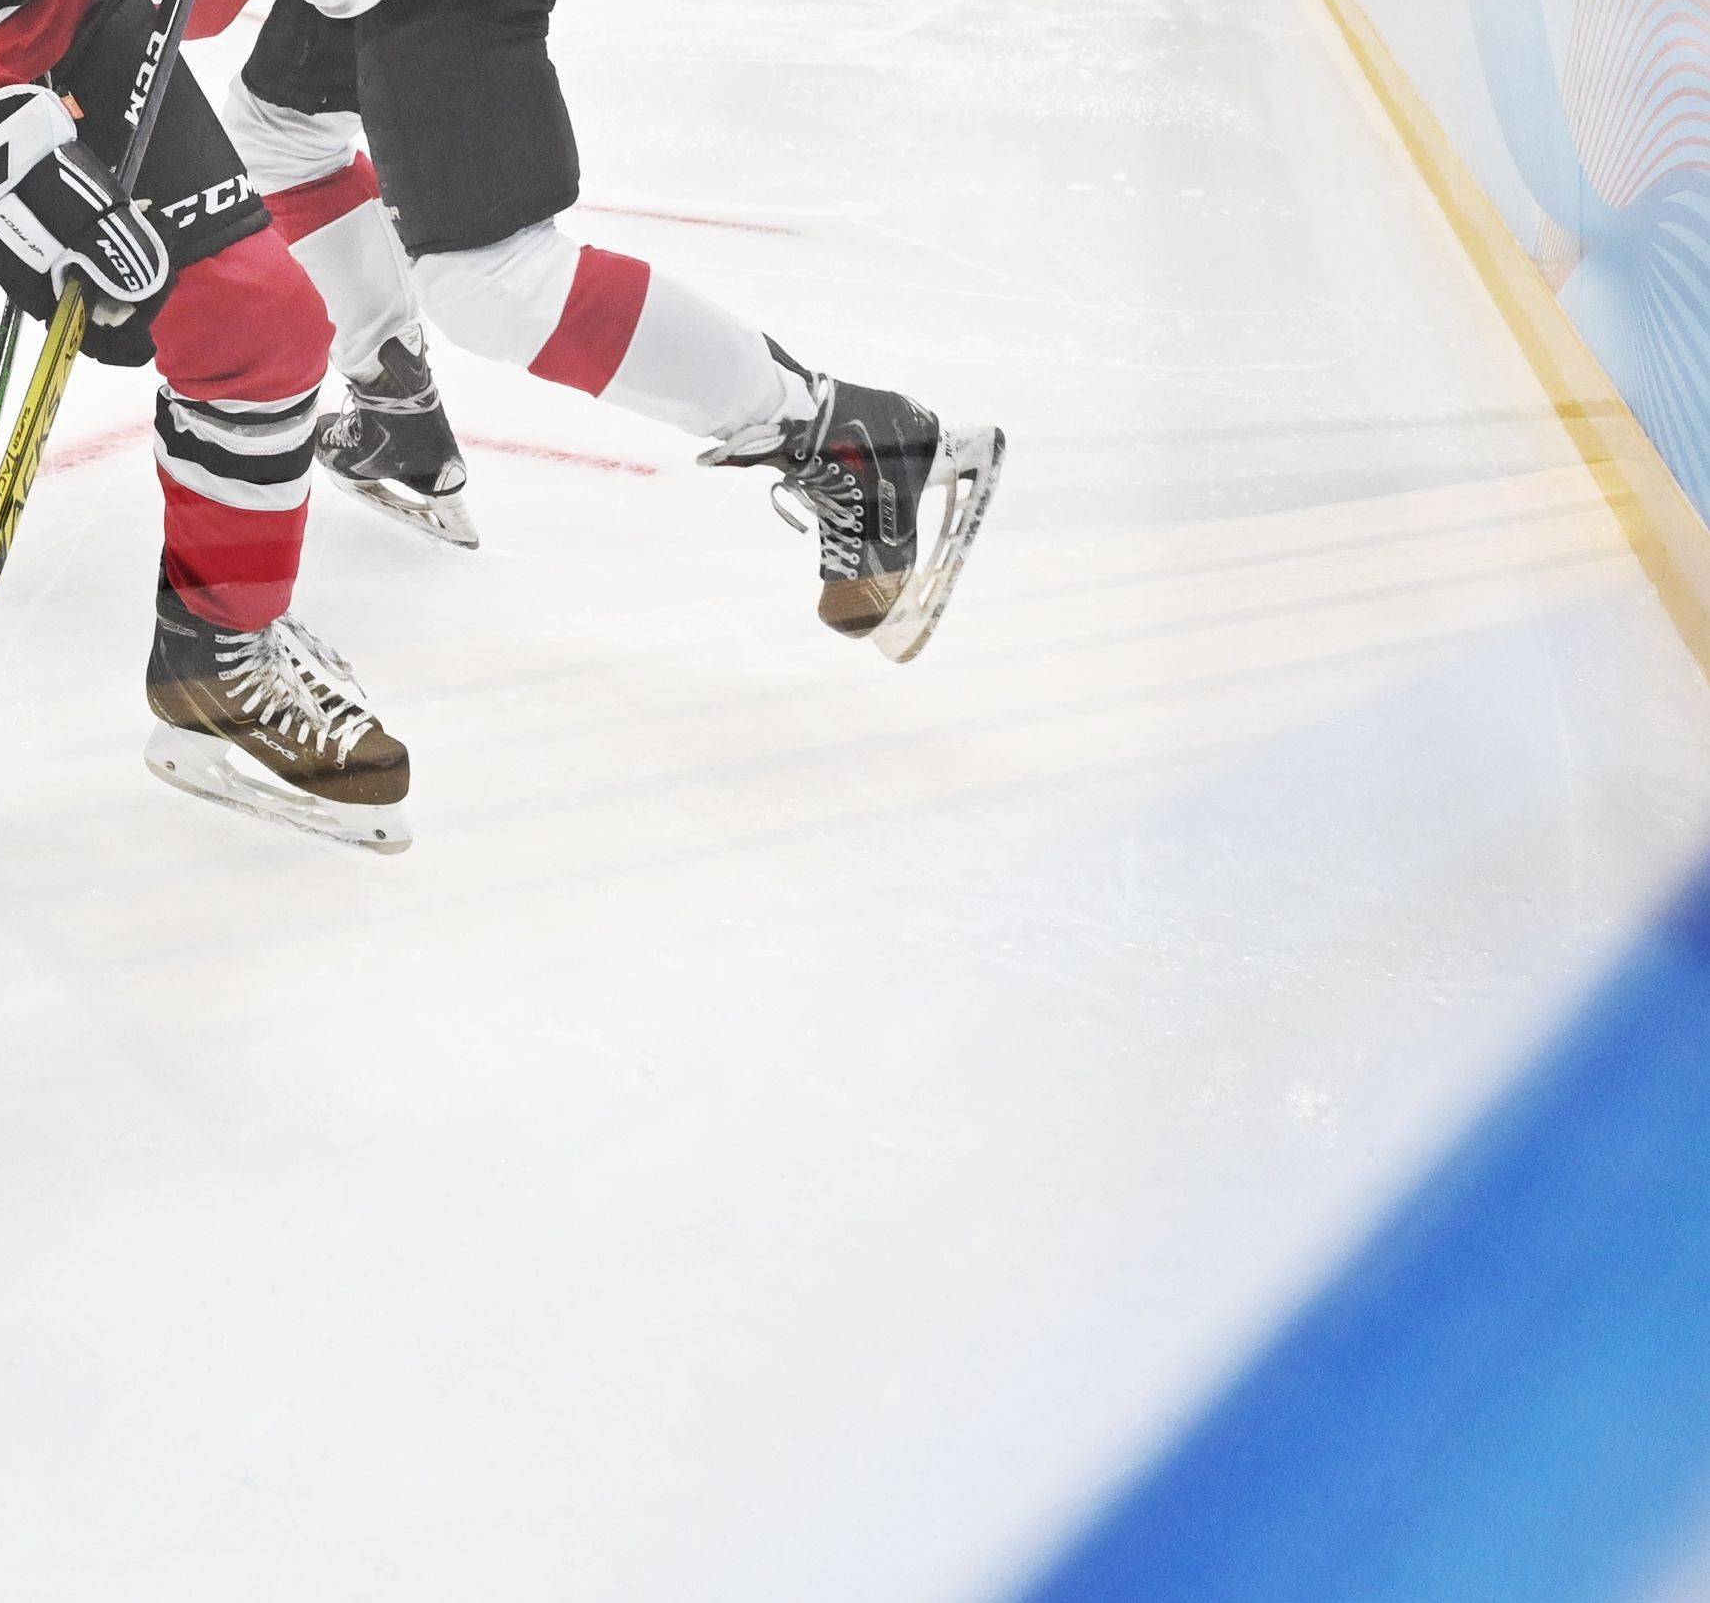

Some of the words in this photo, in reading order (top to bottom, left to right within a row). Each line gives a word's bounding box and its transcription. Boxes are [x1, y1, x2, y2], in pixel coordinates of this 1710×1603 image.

[123, 30, 169, 127] CCM
[159, 173, 260, 229] CCM
[96, 238, 141, 292] CCM
[11, 406, 30, 450] SUPER
[248, 727, 300, 762] TACKS
